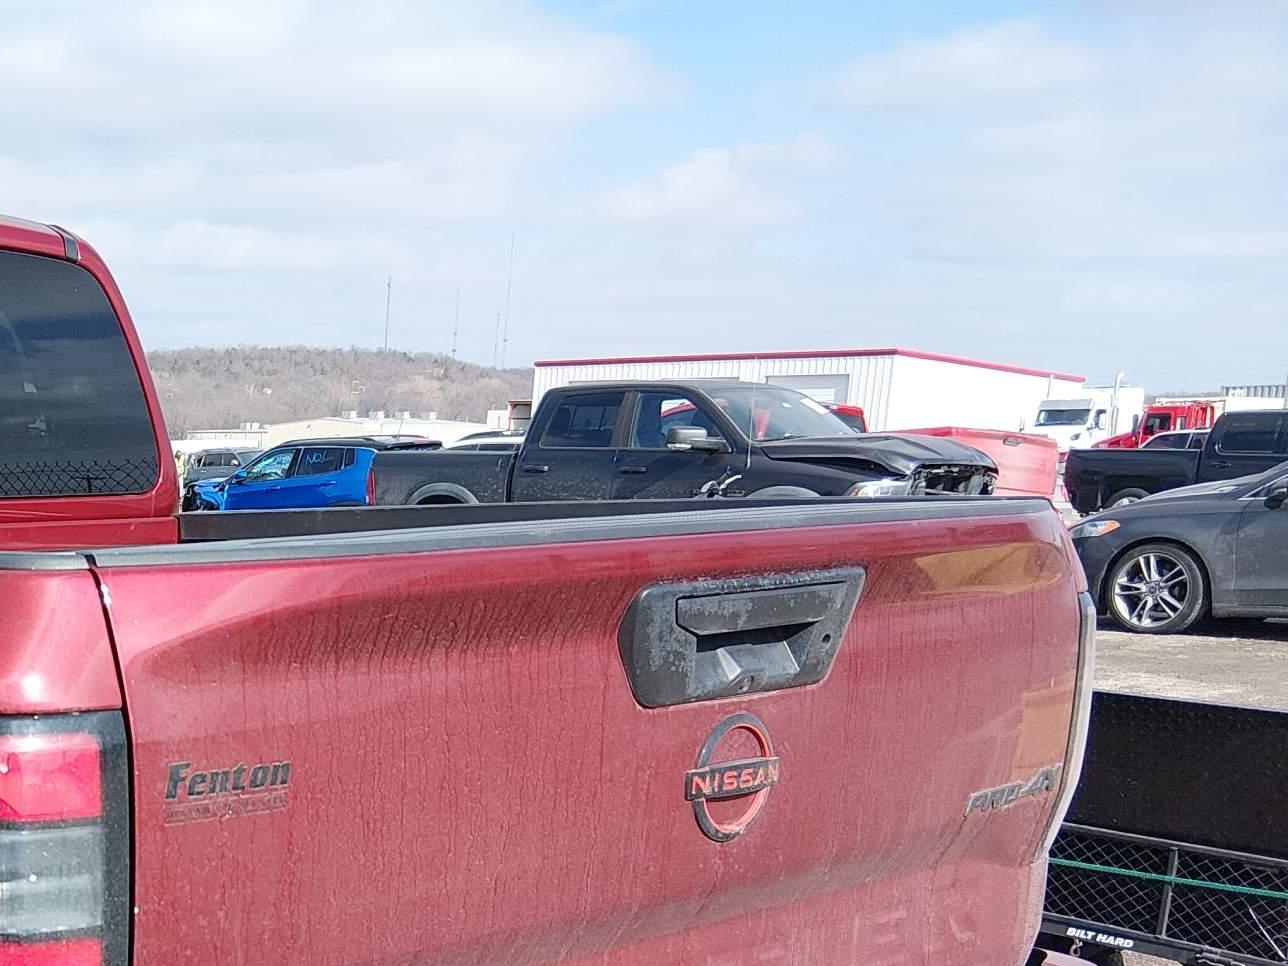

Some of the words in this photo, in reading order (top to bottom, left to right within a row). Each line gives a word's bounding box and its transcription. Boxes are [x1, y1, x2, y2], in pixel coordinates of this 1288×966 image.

[165, 761, 291, 800] Fenton
[691, 764, 779, 795] NISSAN
[1066, 927, 1096, 939] BILT
[1096, 933, 1134, 948] HARD
